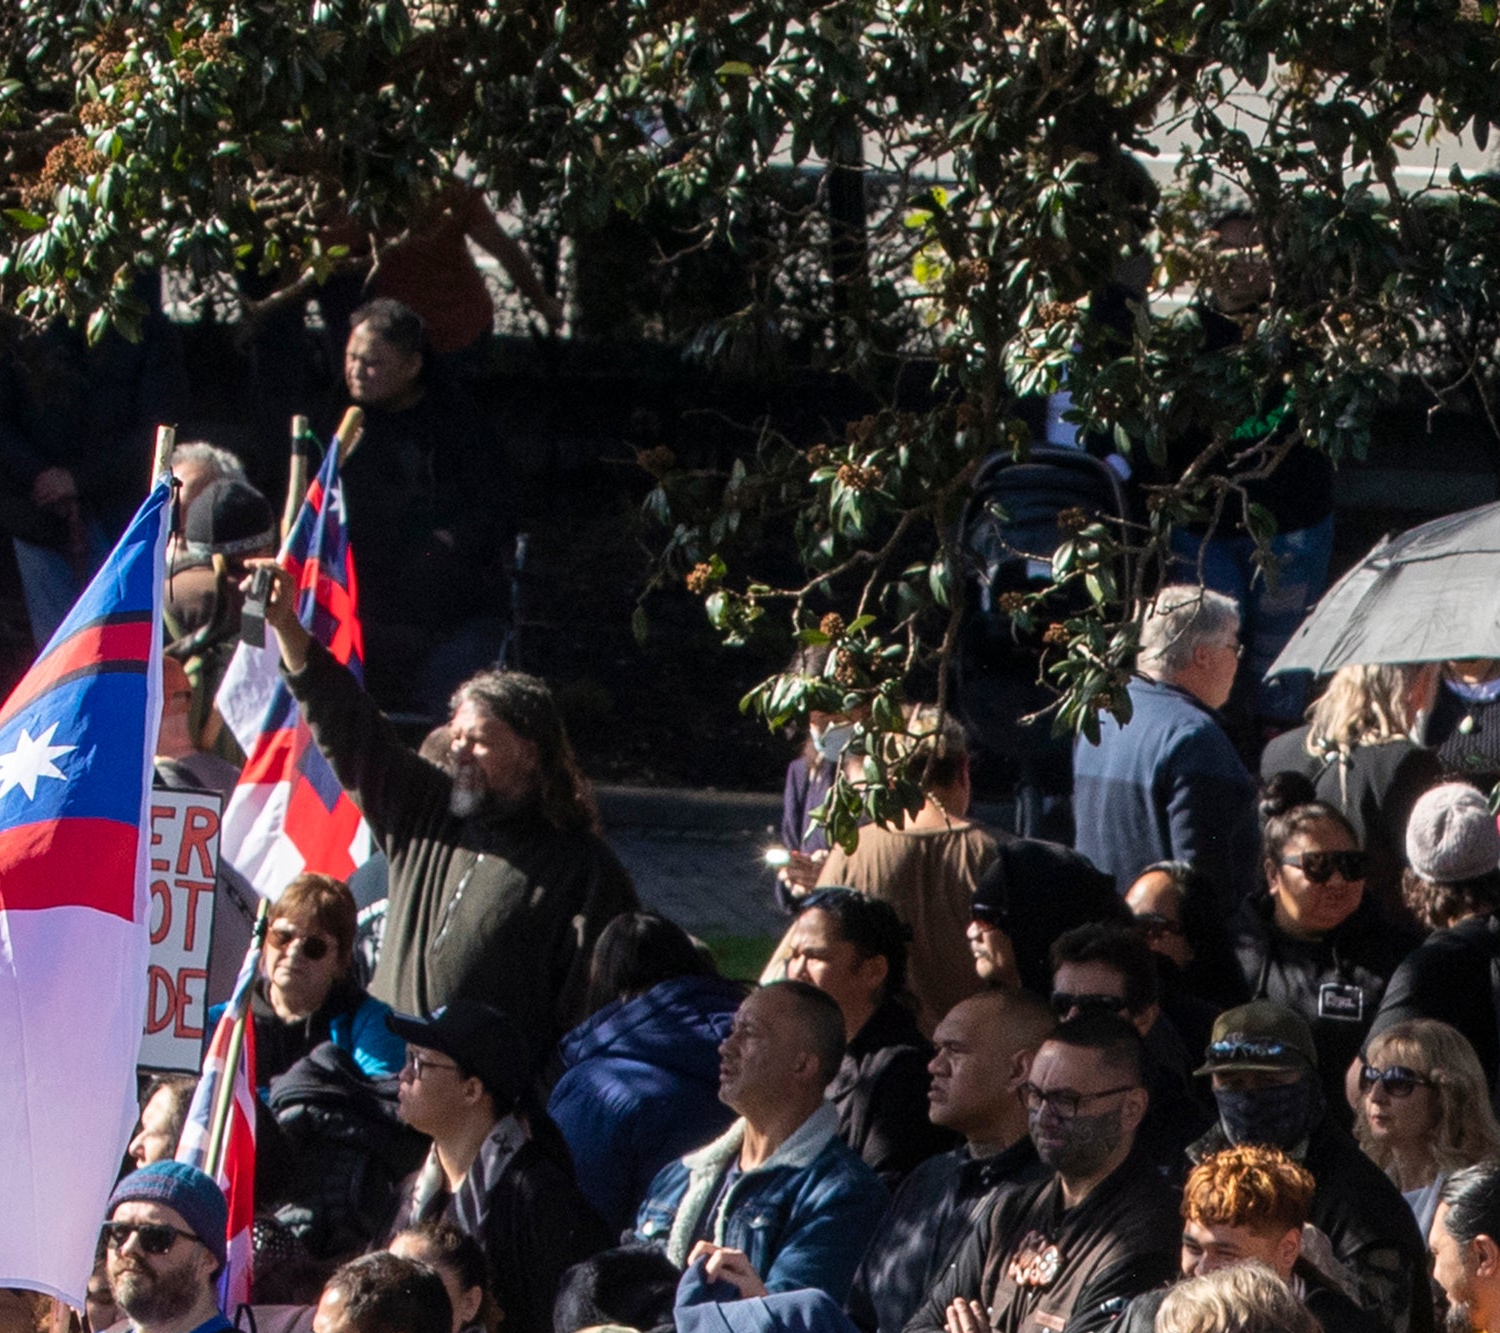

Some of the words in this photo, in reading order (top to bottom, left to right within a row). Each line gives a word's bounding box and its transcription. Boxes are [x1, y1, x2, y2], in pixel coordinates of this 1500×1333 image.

[151, 805, 220, 879] ER
[150, 879, 215, 952] OT
[146, 965, 210, 1039] DE
